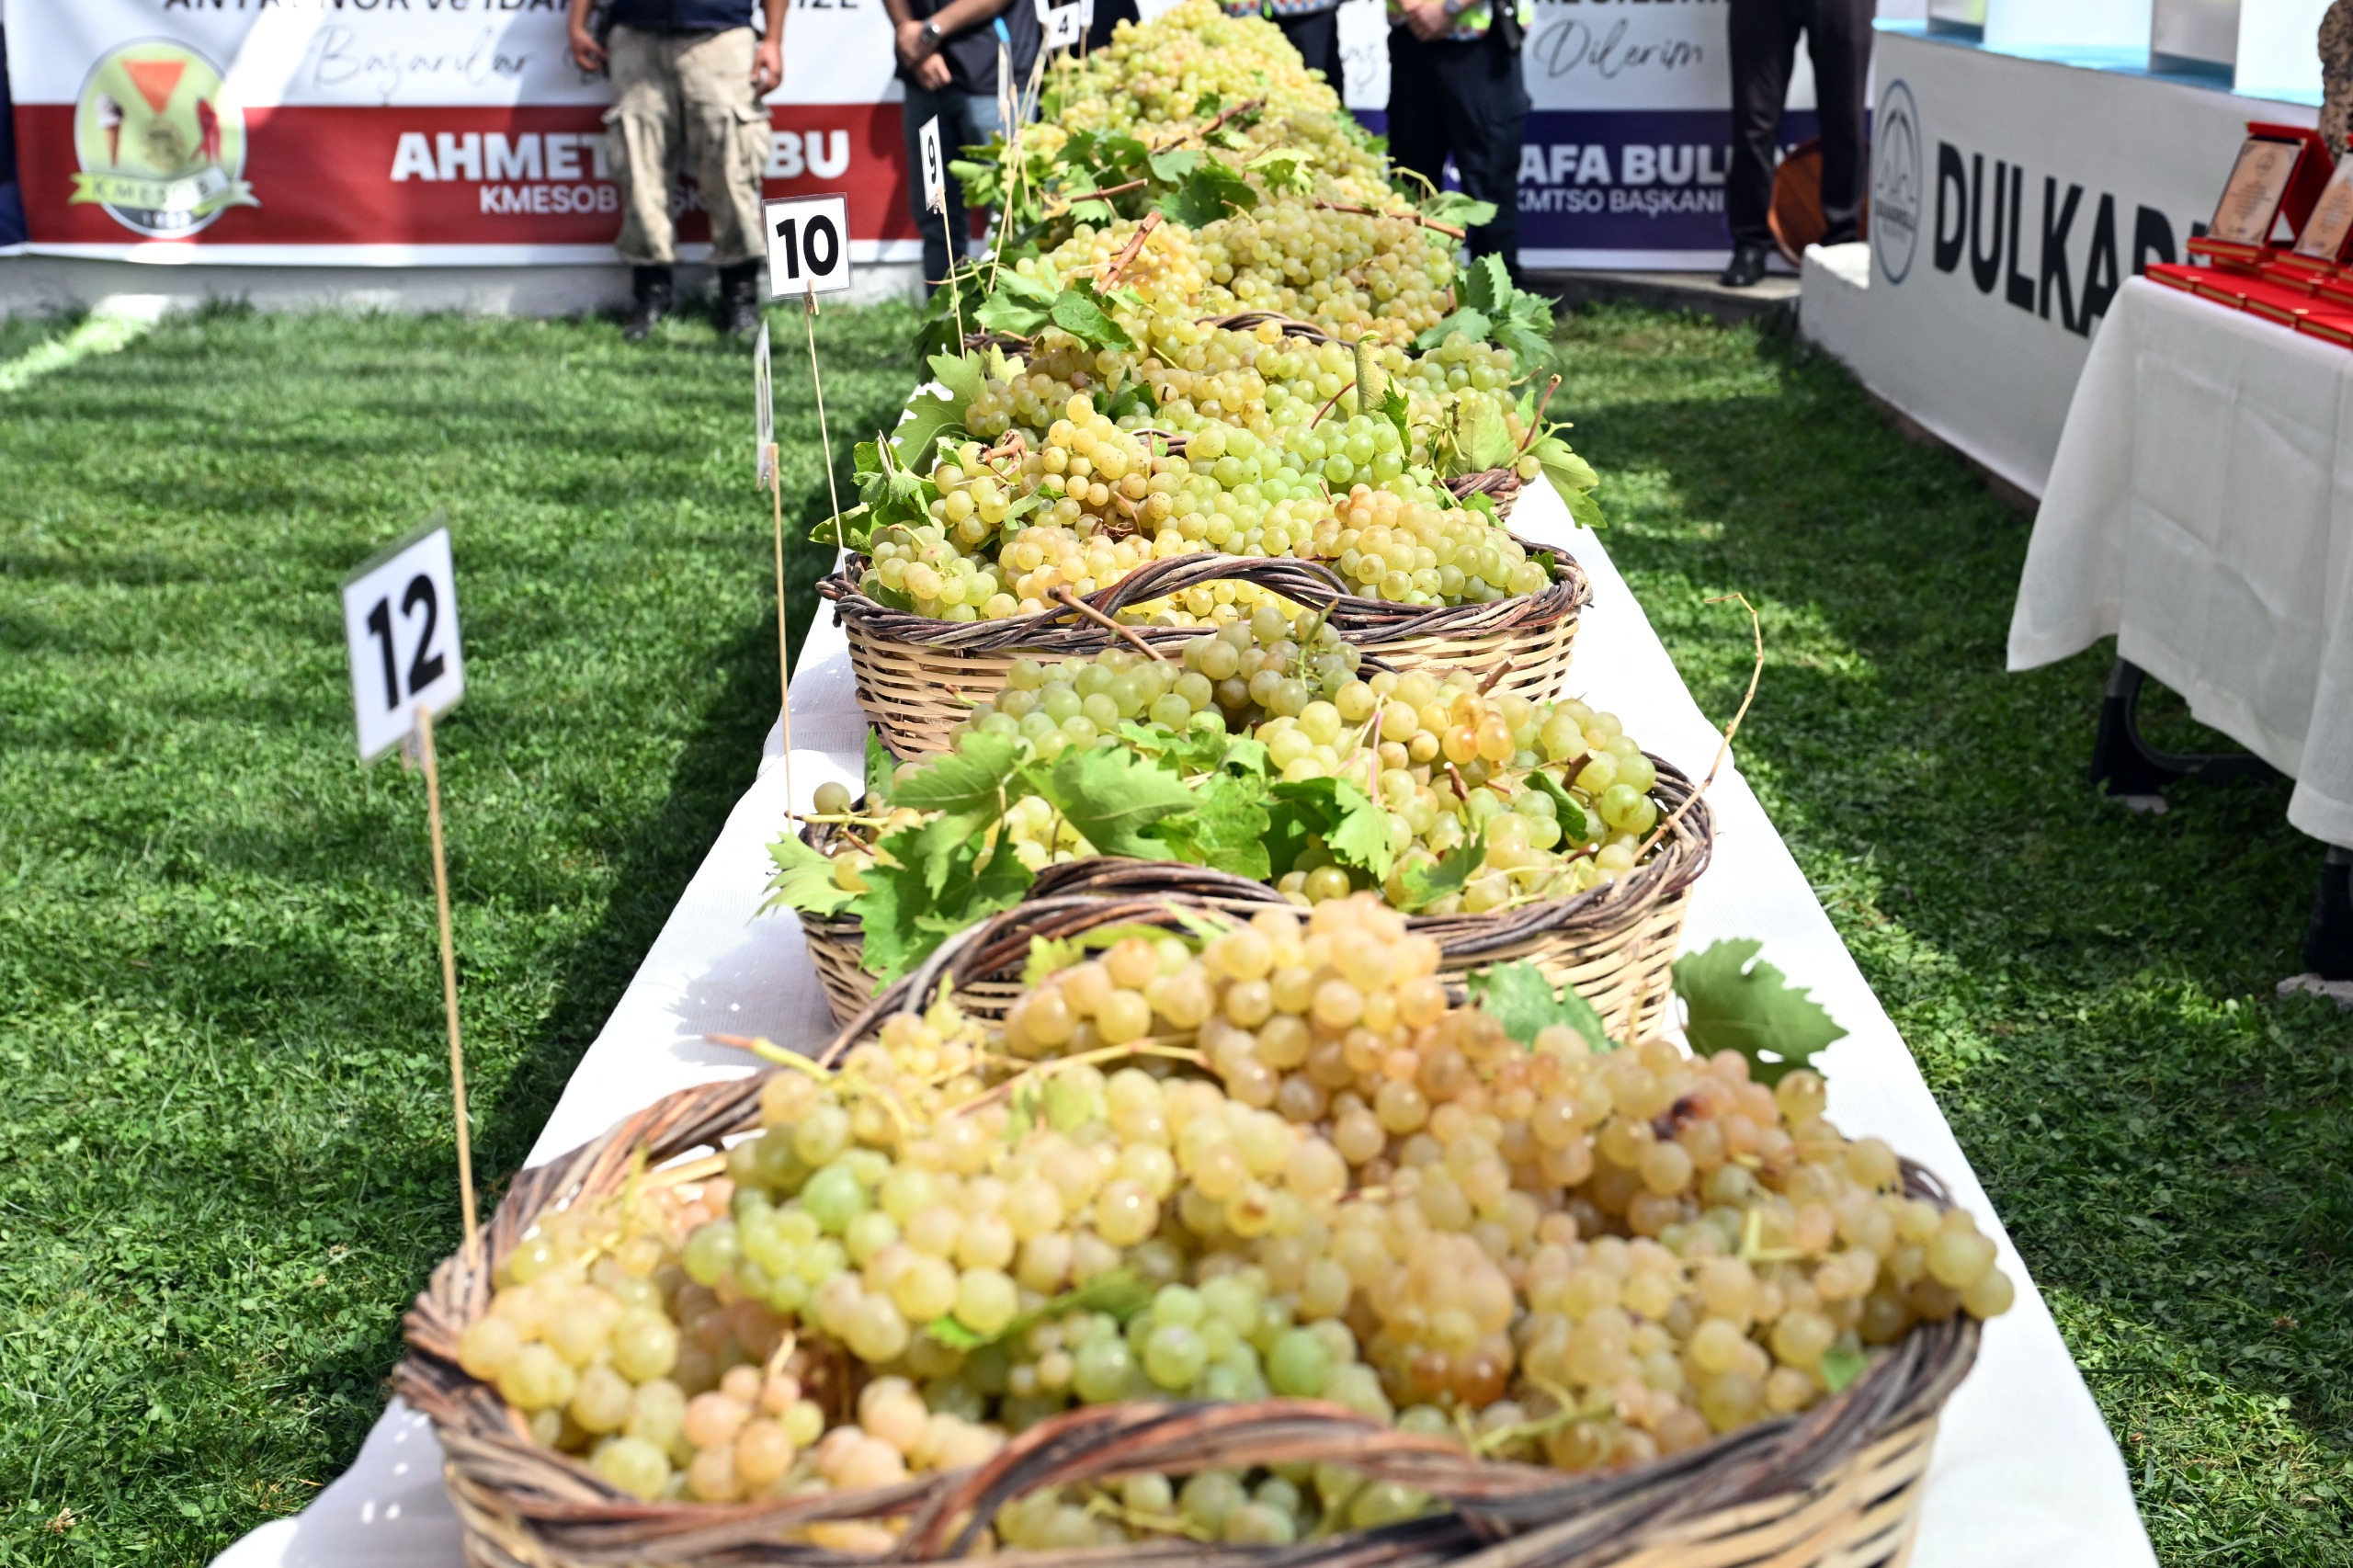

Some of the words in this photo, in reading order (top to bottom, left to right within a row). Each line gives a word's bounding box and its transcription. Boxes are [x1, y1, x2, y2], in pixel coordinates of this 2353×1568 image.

[1058, 13, 1069, 35] 4
[1532, 17, 1704, 79] Dilerim
[390, 131, 608, 182] AHMET
[927, 134, 938, 185] 9
[480, 185, 619, 214] KMESOB
[1608, 188, 1724, 218] BAŞKANI
[776, 214, 839, 279] 10
[366, 573, 445, 711] 12
